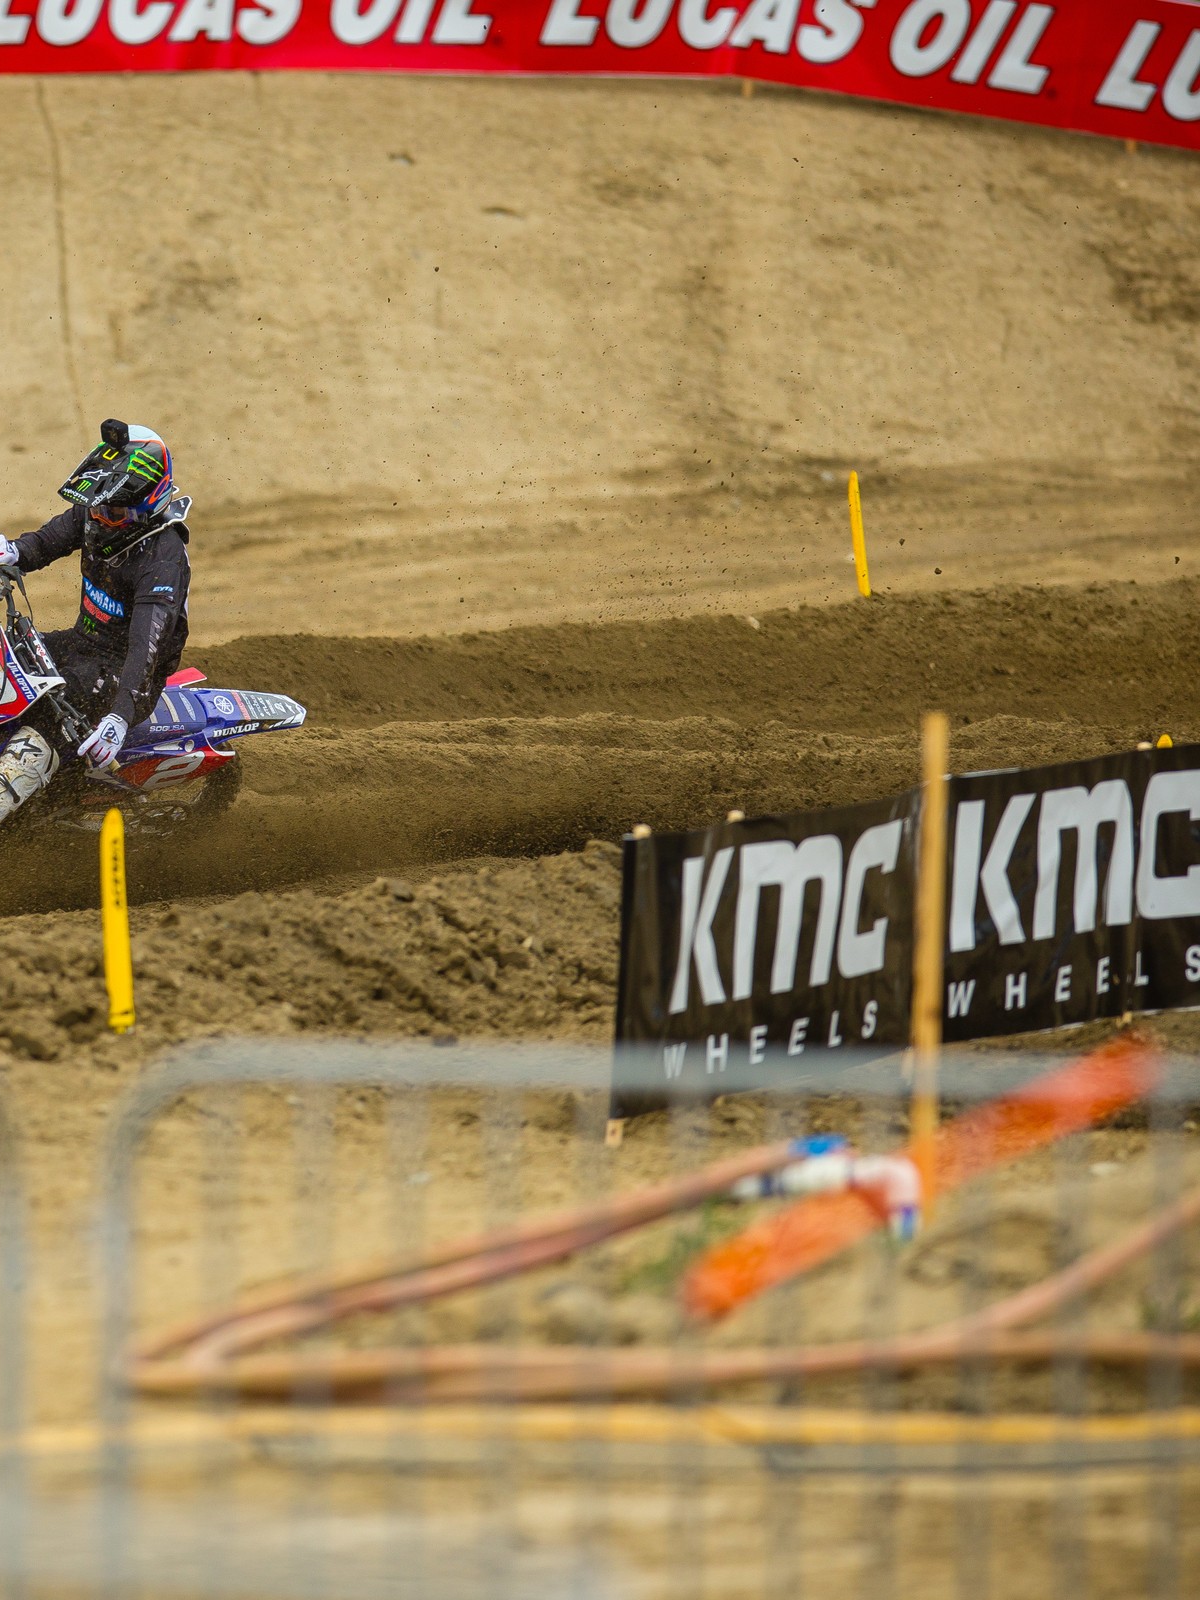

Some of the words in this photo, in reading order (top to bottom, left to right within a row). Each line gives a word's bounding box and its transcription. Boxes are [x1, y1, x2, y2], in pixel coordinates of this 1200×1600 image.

[539, 0, 879, 64] LUCAS
[889, 0, 1054, 95] OIL
[85, 581, 123, 616] YAMAHA
[6, 661, 35, 700] VILLOPOTO
[213, 722, 260, 738] DUNLOP
[948, 944, 1200, 1018] WHEELS
[663, 1000, 878, 1080] WHEELS
